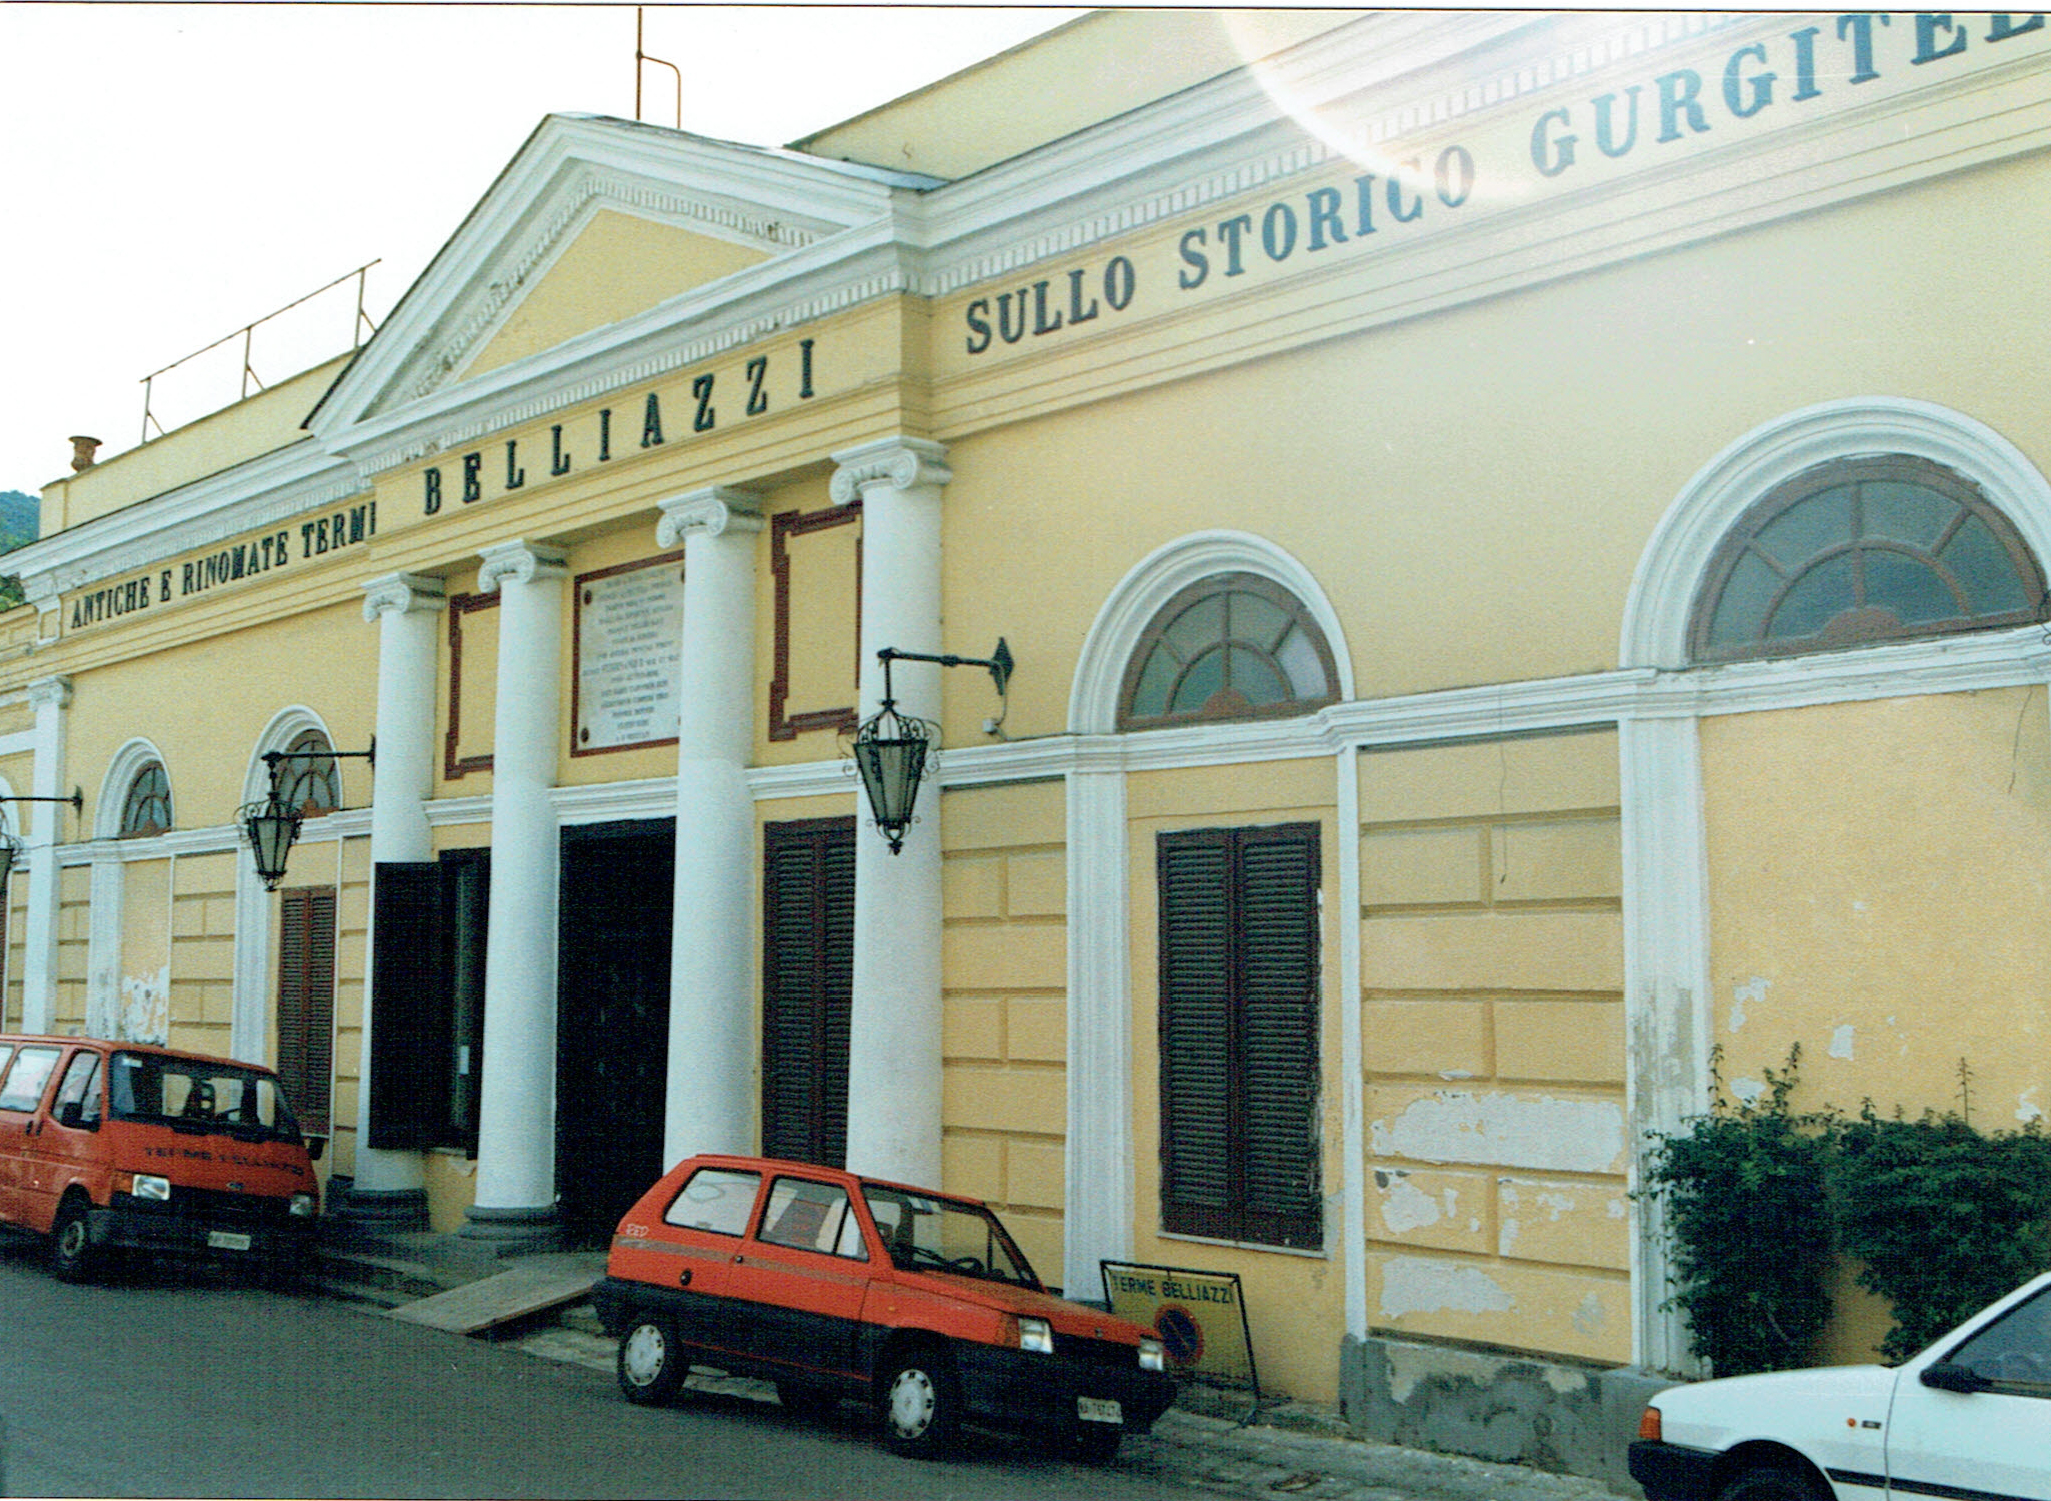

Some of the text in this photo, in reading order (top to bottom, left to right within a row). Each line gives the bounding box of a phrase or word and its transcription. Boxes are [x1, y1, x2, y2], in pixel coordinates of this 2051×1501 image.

[966, 256, 1135, 354] SULLO
[1179, 145, 1475, 290] STORICO
[423, 339, 816, 515] BELLIAZZI
[71, 577, 150, 630] ANTICHE
[160, 570, 172, 602] E
[182, 531, 289, 596] RINOMATE
[1112, 1275, 1235, 1304] TERME BELLIAZZI
